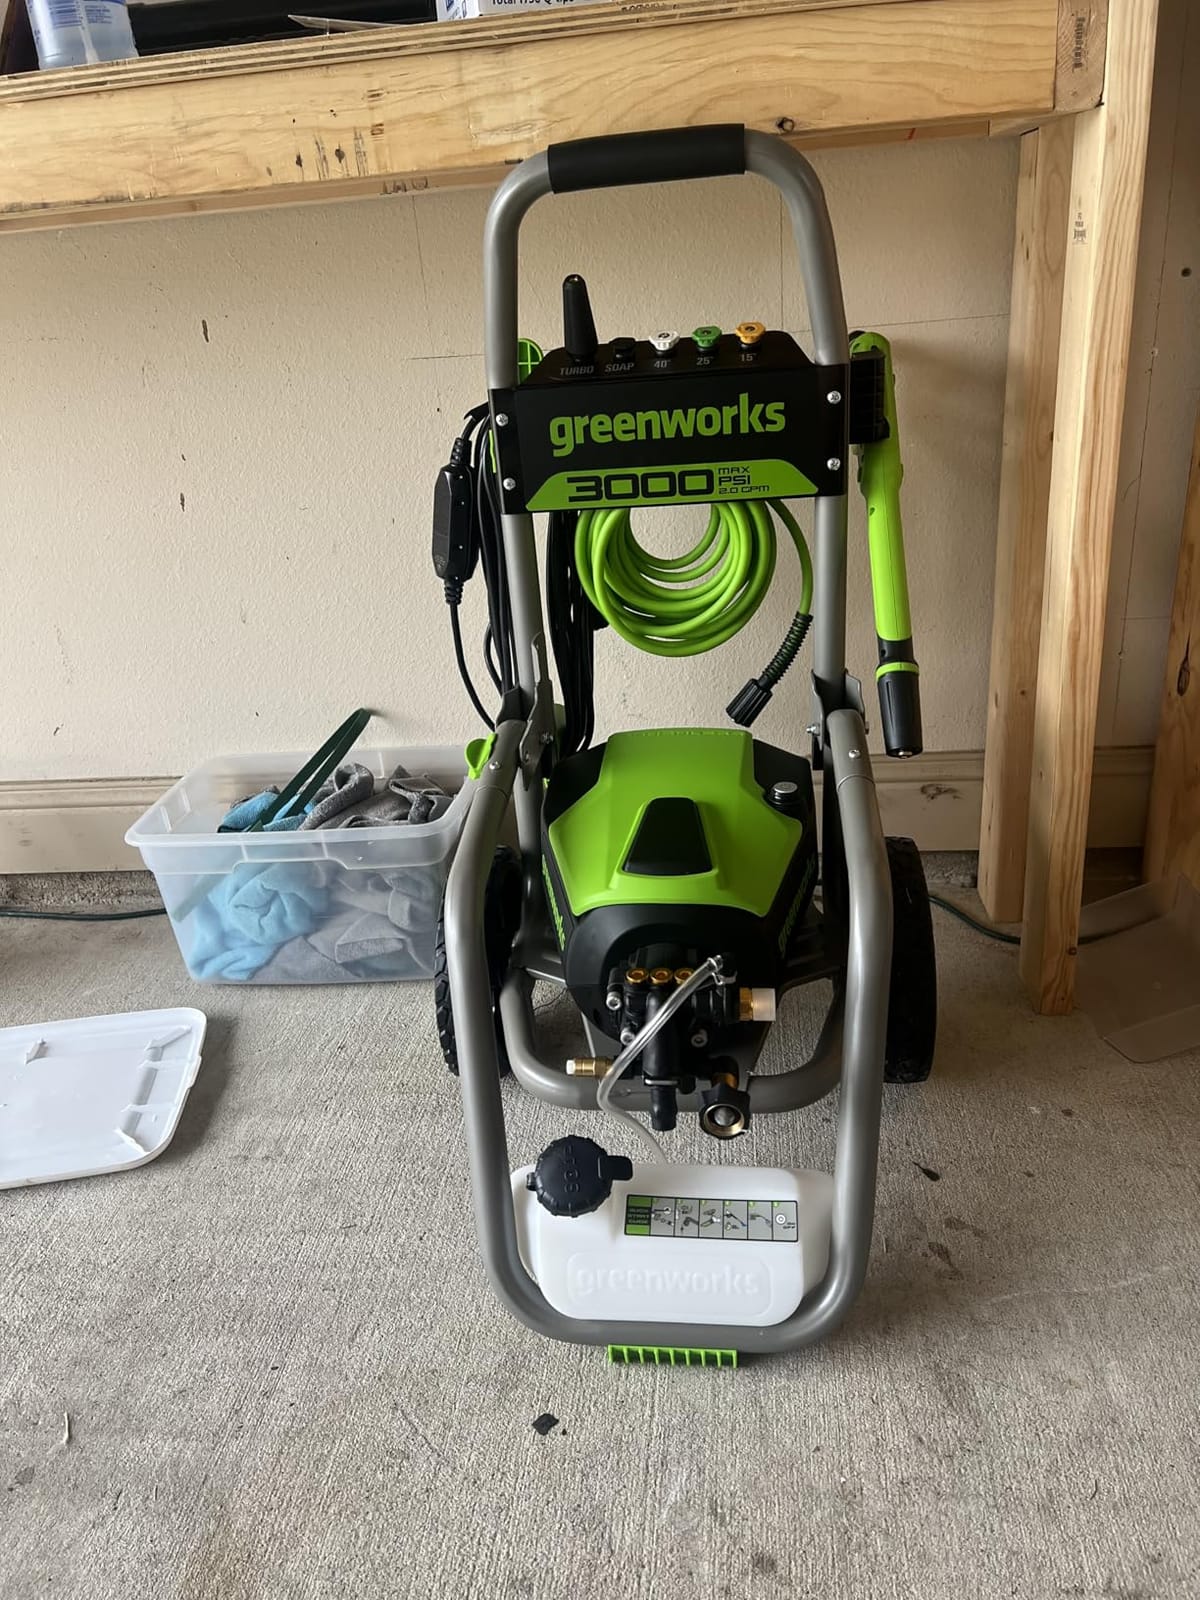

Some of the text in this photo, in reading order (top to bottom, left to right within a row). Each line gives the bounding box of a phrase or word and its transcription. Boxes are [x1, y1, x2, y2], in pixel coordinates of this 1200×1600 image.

[559, 365, 595, 376] TURBO
[604, 362, 635, 373] SOAP
[549, 392, 787, 457] greenworks
[717, 466, 751, 475] MAX
[566, 469, 715, 503] 3000
[718, 475, 751, 486] PSI
[718, 485, 770, 495] 2.0 GPM
[575, 1264, 760, 1297] greenworks
